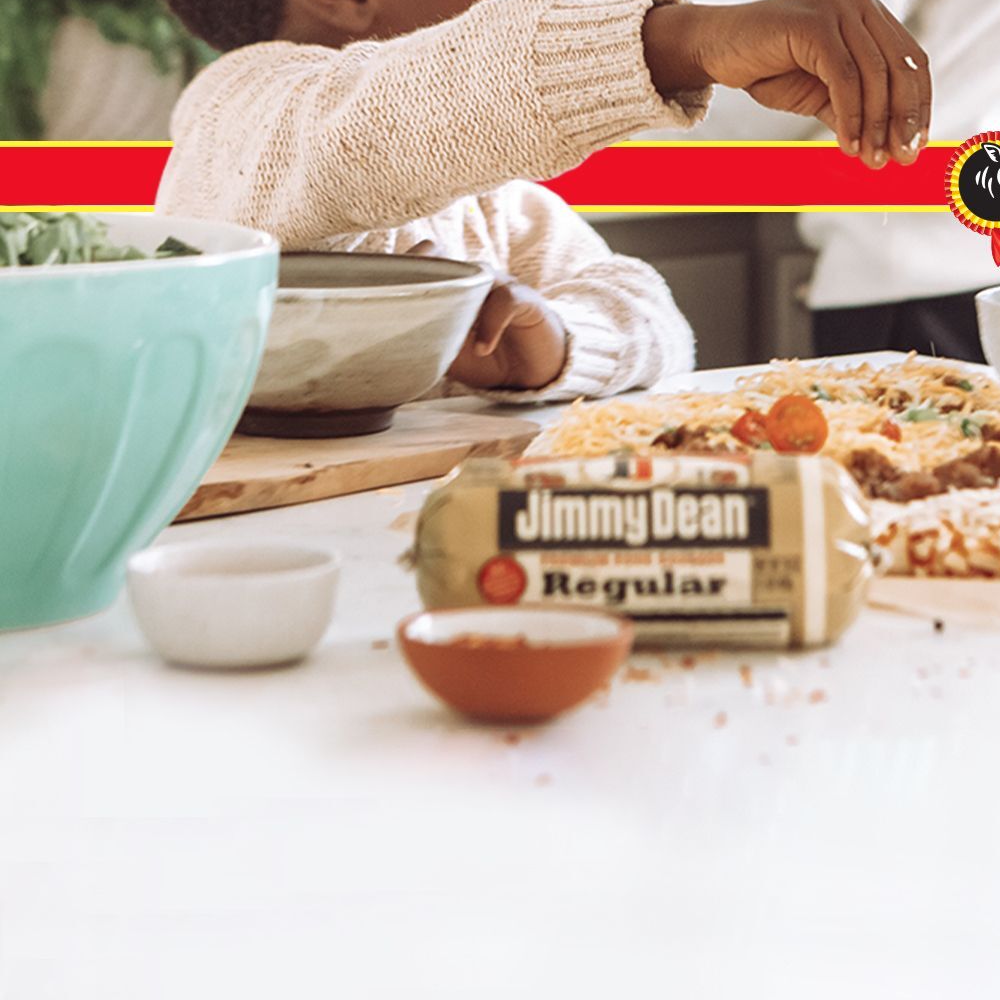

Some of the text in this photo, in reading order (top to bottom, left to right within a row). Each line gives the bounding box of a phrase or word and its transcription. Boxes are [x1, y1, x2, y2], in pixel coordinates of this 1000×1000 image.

[514, 487, 749, 546] Jimmy Dean
[541, 570, 727, 605] Regular
